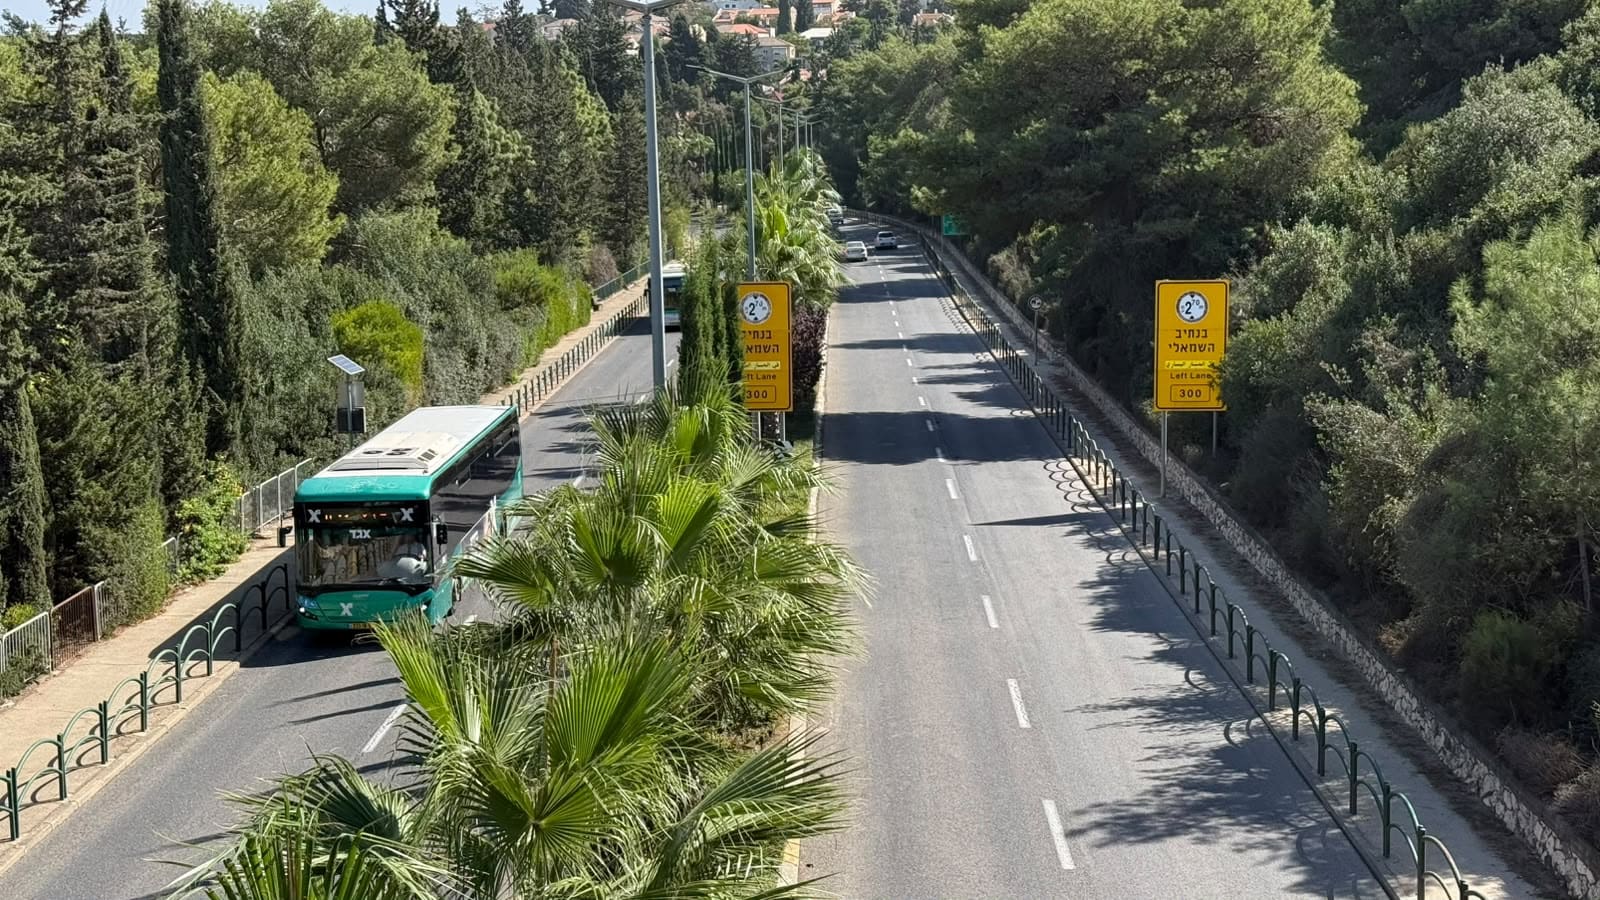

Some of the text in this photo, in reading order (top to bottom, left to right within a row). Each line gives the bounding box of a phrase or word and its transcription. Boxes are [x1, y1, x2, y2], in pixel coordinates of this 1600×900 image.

[1175, 329, 1208, 339] בנתיב
[745, 344, 779, 354] השמא
[1168, 342, 1215, 353] השמאלי
[1170, 372, 1211, 380] Left Lane
[746, 390, 768, 399] 300
[1179, 389, 1202, 398] 300
